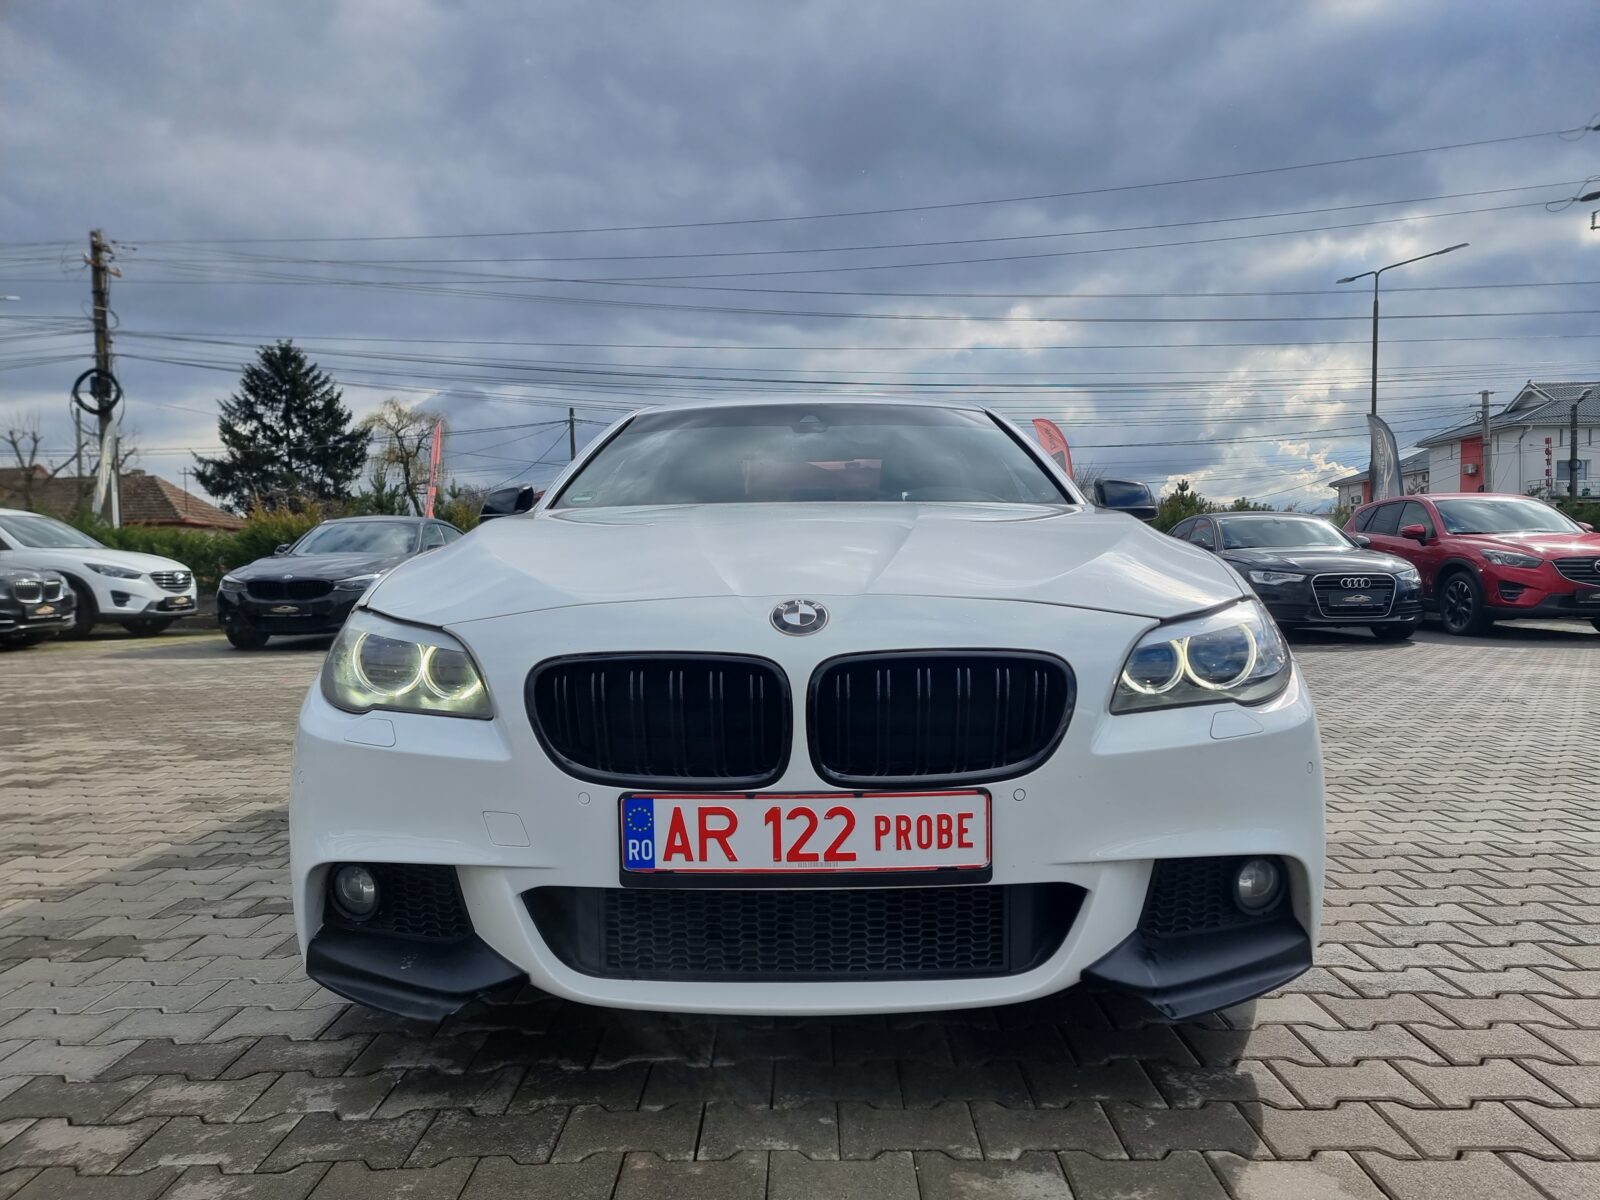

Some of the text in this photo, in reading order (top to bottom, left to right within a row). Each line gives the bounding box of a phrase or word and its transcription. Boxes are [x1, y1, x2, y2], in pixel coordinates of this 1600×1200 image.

[628, 839, 653, 861] RO
[662, 806, 974, 862] AR 122 PROBE
